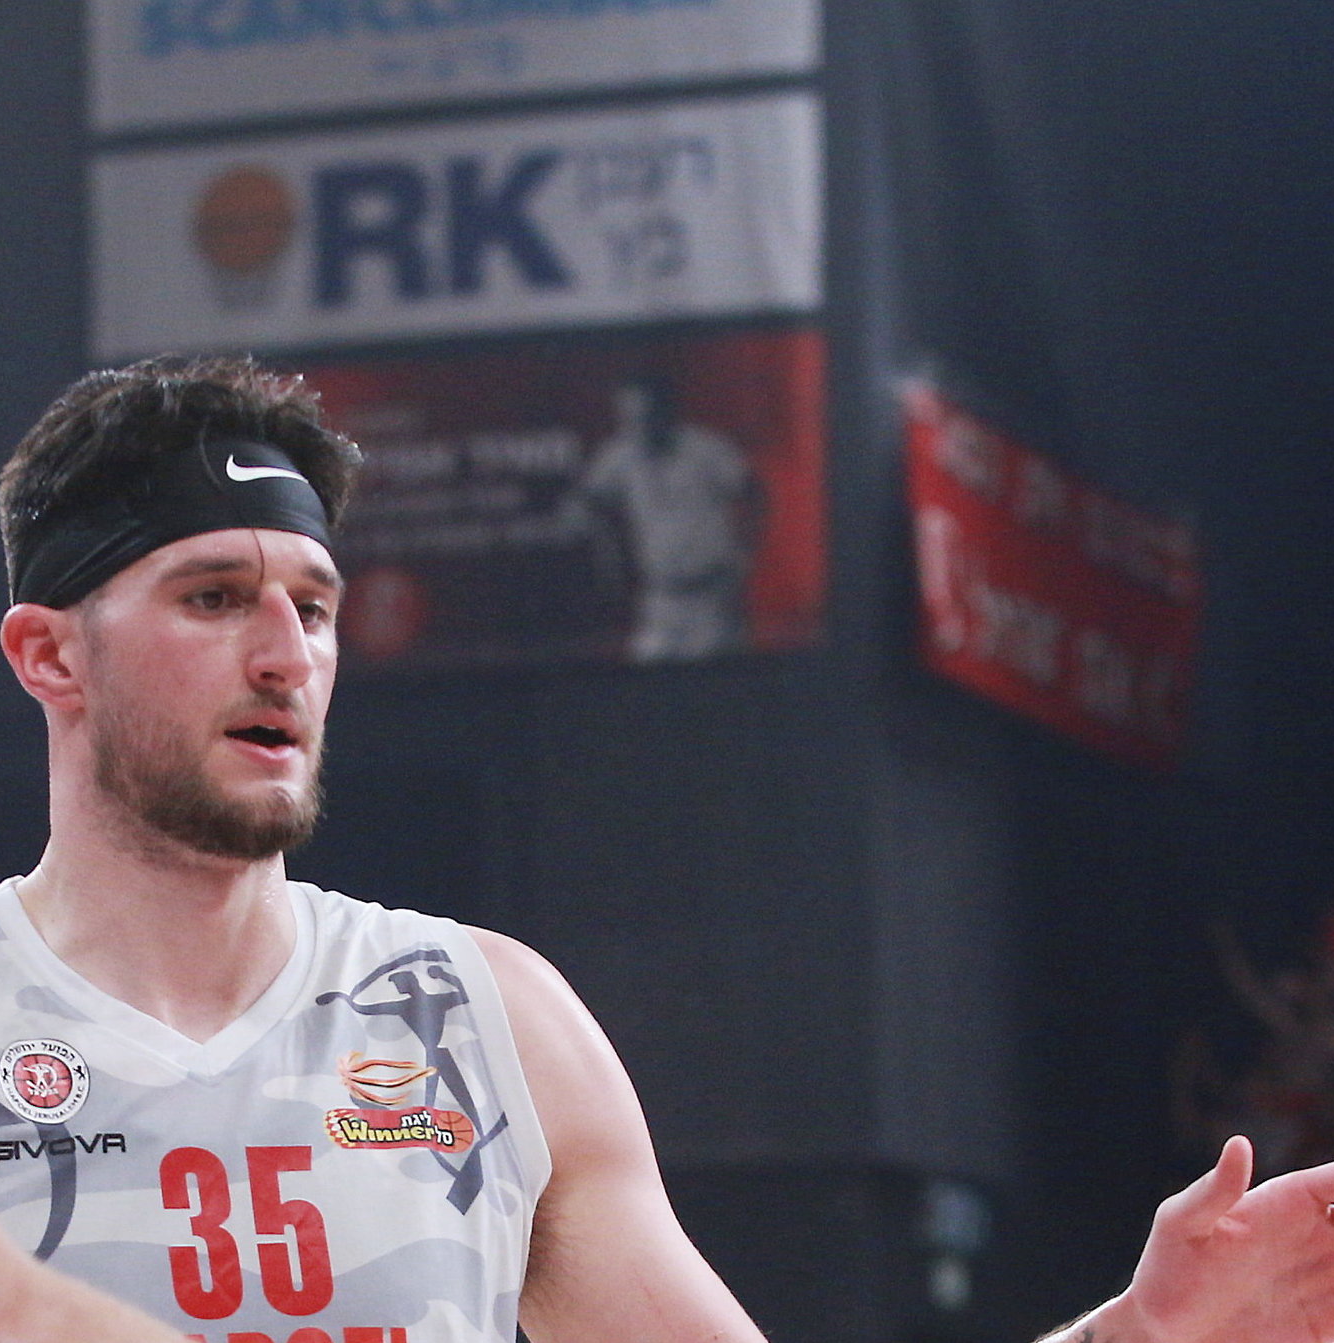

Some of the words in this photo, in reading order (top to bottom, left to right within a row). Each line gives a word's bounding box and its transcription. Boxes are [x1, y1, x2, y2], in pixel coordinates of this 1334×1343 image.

[312, 147, 573, 309] RK
[340, 1117, 435, 1142] Winner
[401, 1110, 432, 1128] ליגת
[434, 1124, 454, 1146] סל
[159, 1145, 334, 1320] 35
